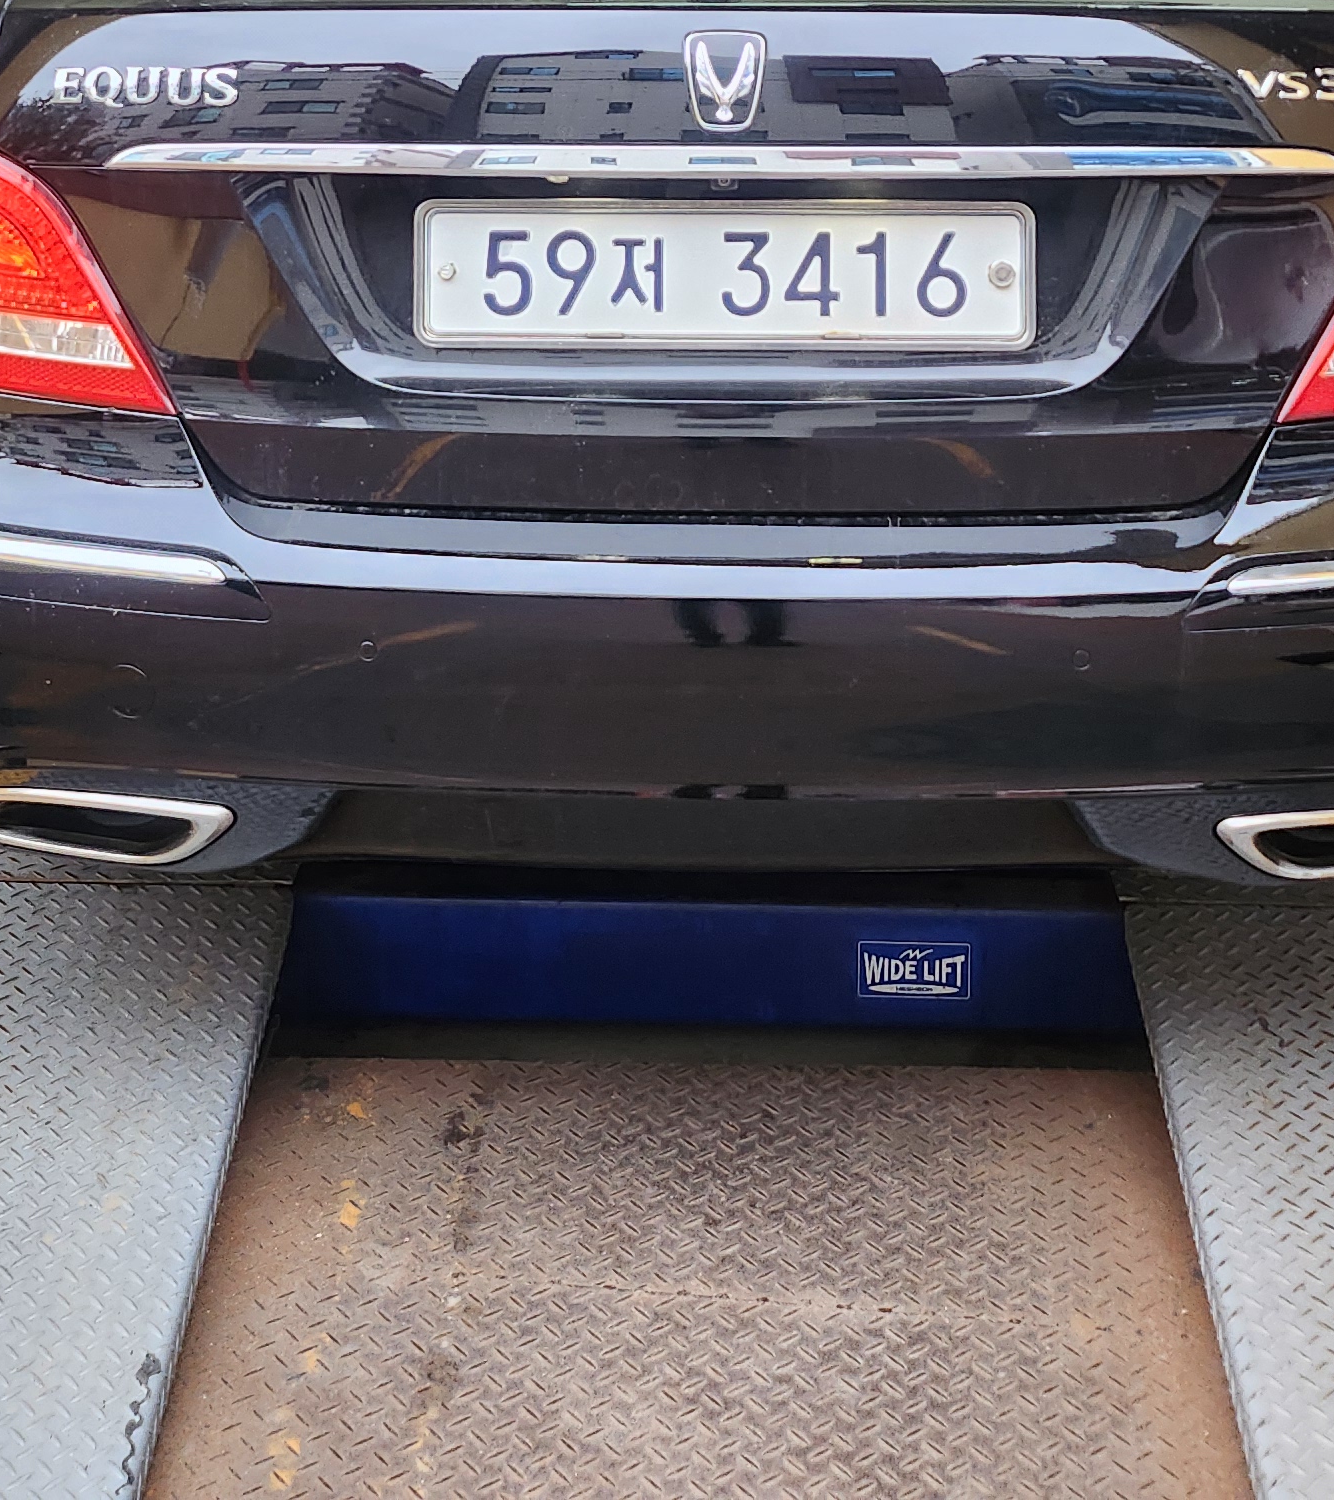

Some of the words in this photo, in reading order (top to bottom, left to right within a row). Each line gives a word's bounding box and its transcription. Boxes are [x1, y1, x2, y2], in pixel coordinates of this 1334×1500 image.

[50, 65, 239, 108] EQUUS
[482, 228, 665, 317] 59저
[720, 230, 969, 318] 3416
[863, 951, 918, 985] WIDE
[923, 954, 966, 988] LIFT
